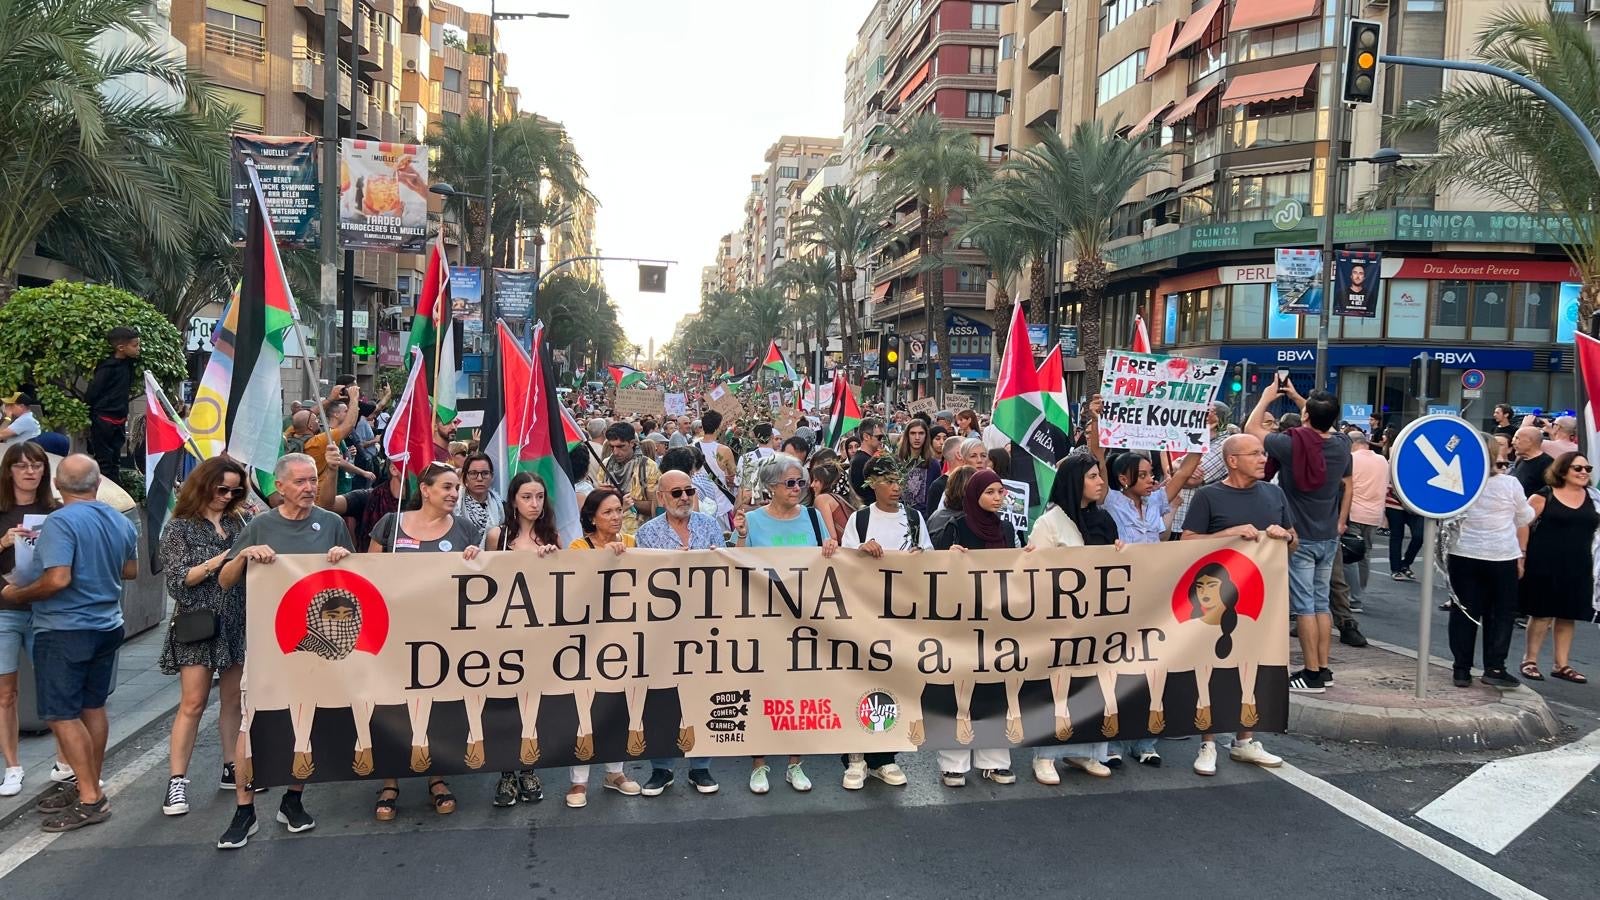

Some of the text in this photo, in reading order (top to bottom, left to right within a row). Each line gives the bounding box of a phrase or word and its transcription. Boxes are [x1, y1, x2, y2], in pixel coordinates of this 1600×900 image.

[366, 215, 402, 226] TARDEO
[1398, 214, 1477, 229] CLINICA
[341, 222, 425, 236] ATARDECERES EL MUELLE
[1196, 226, 1238, 238] CLINICA
[1191, 237, 1240, 249] MONUMENTAL
[1236, 267, 1275, 281] PERL
[1423, 263, 1520, 276] Dra. Joanet Perera
[948, 326, 979, 336] ASSSA
[1277, 349, 1315, 361] BBVA
[1434, 352, 1476, 364] BBVA
[1100, 401, 1144, 425] #FREE
[1350, 405, 1365, 416] Ya
[1033, 429, 1056, 453] PALES
[451, 564, 1133, 630] PALESTINA LLIURE
[404, 625, 1166, 690] Des del riu fins a la mar
[716, 694, 736, 703] PROU
[713, 708, 737, 717] COMERÇ
[763, 699, 795, 716] BDS
[716, 733, 745, 743] ISRAEL
